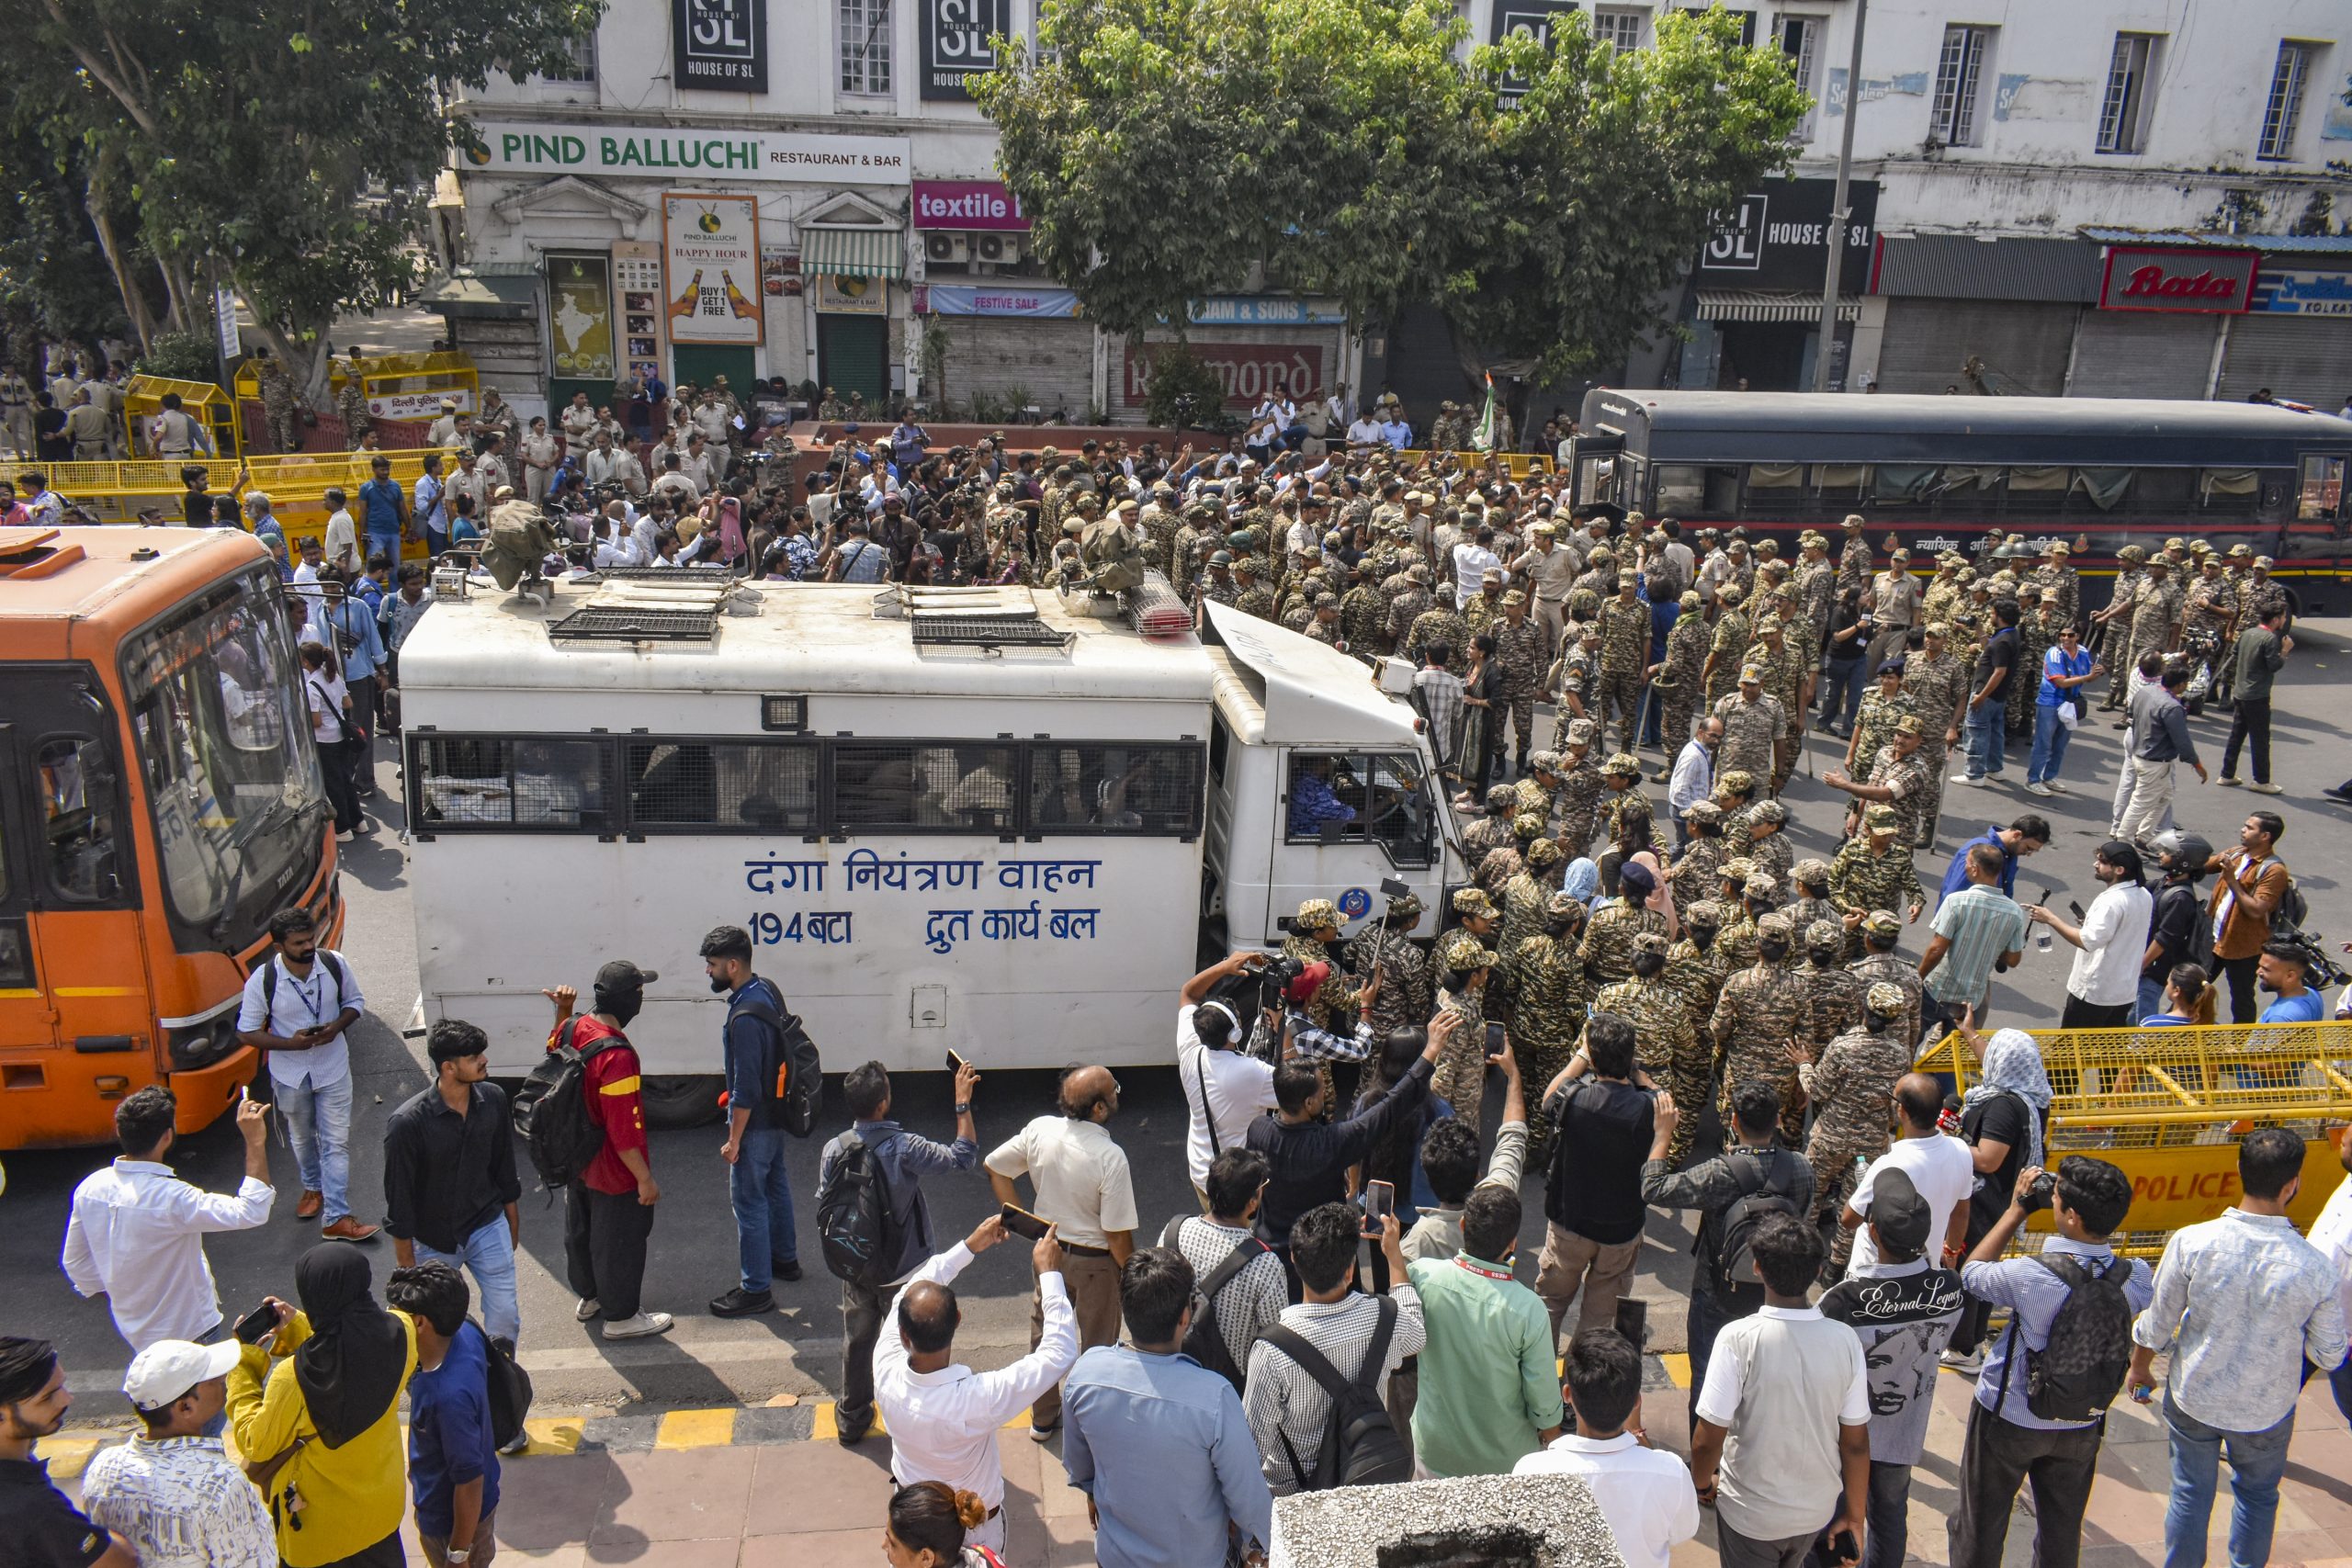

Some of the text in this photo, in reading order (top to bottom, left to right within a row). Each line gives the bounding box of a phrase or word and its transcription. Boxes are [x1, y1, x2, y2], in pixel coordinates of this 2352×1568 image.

[688, 61, 754, 78] HOUSE OF SL
[502, 133, 901, 170] PIND BALLUCHI RESTAURANT & BAR
[920, 194, 1006, 218] textile
[1769, 222, 1823, 245] HOUSE
[1850, 225, 1869, 246] SL
[675, 248, 748, 259] HAPPY HOUR
[700, 287, 726, 297] BUY 1
[2120, 265, 2237, 298] Bata
[702, 297, 725, 306] GET 1
[703, 307, 725, 316] FREE
[975, 297, 1038, 310] FESTIVE SALE
[1240, 302, 1252, 320] &
[1257, 301, 1298, 320] SONS
[1128, 351, 1312, 399] Rmond
[392, 395, 439, 407] दिल्ली पुलिस
[744, 848, 1102, 895] दंगा नियंत्रण वाहन
[924, 900, 1102, 954] द्रुत कार्य बल
[2131, 1171, 2238, 1203] POLICE
[1465, 1264, 1484, 1274] PRESS
[1852, 1276, 1963, 1318] Eternal Legacy
